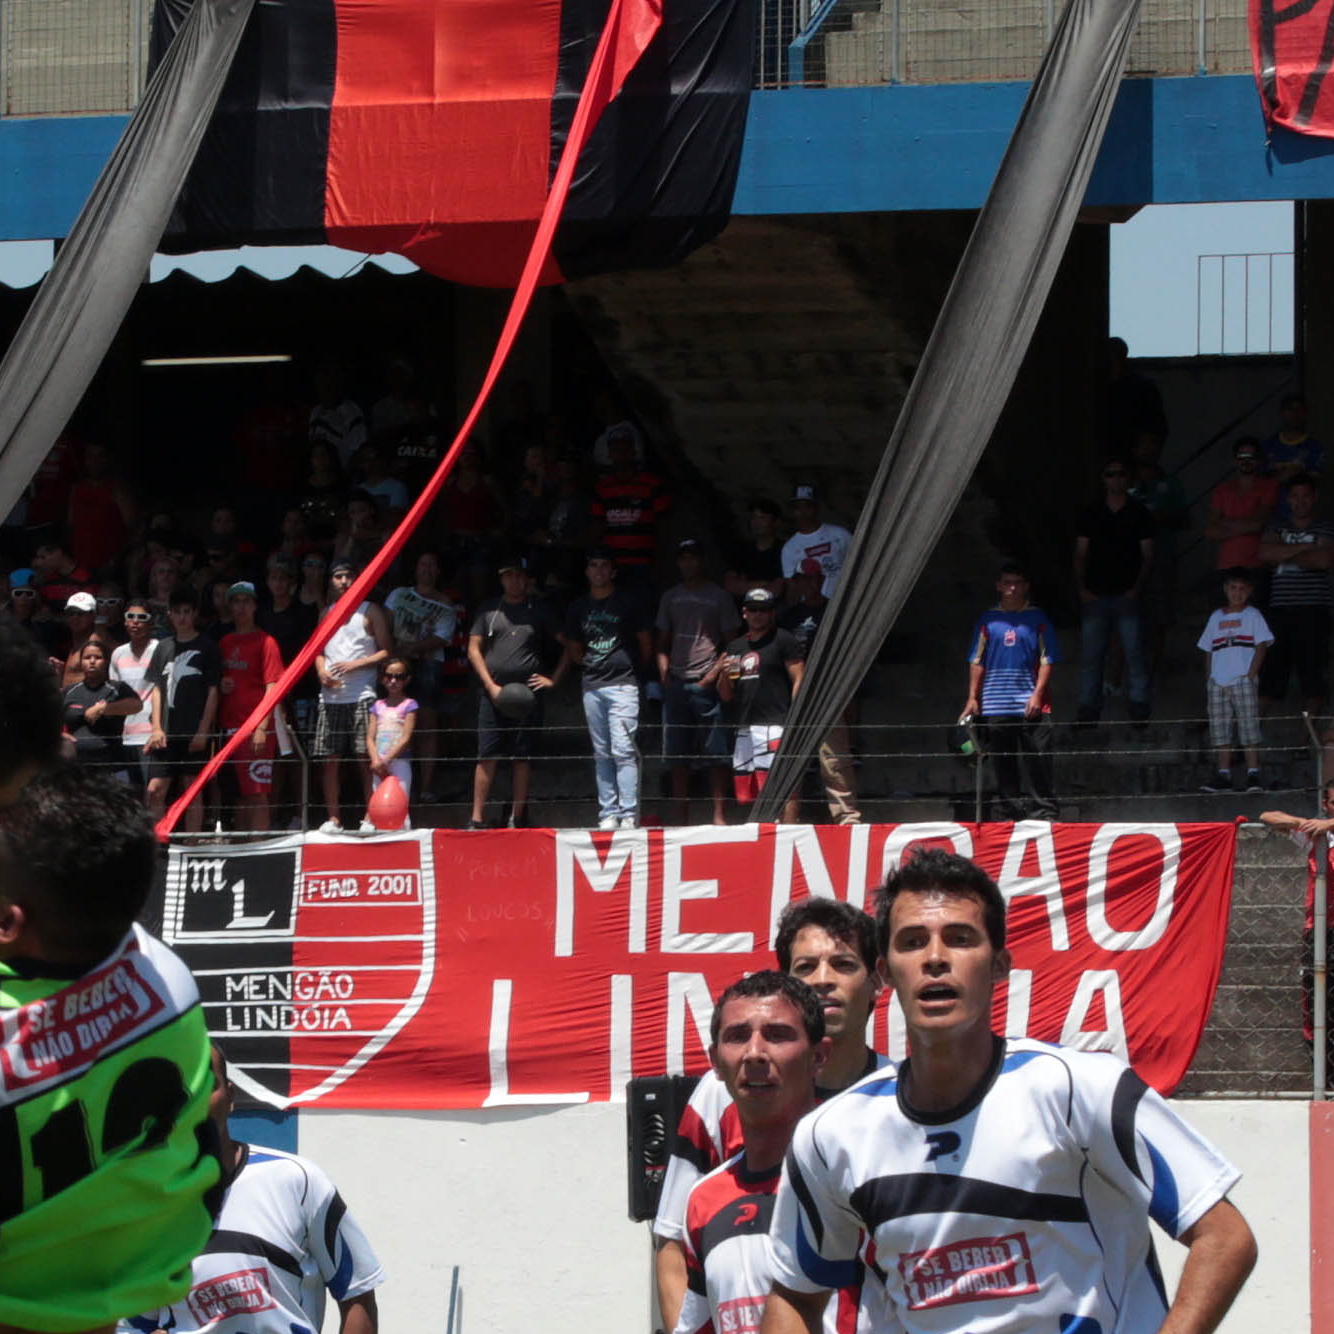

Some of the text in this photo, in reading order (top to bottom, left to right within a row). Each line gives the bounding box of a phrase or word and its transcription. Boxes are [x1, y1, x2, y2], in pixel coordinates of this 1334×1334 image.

[307, 874, 413, 900] FUND. 2001
[26, 963, 130, 1033] SE BEBER
[224, 971, 355, 1001] MENGÃO
[225, 1001, 353, 1032] LINDÓIA
[29, 1031, 75, 1068] NÃO
[920, 1245, 1007, 1277] SE BEBER
